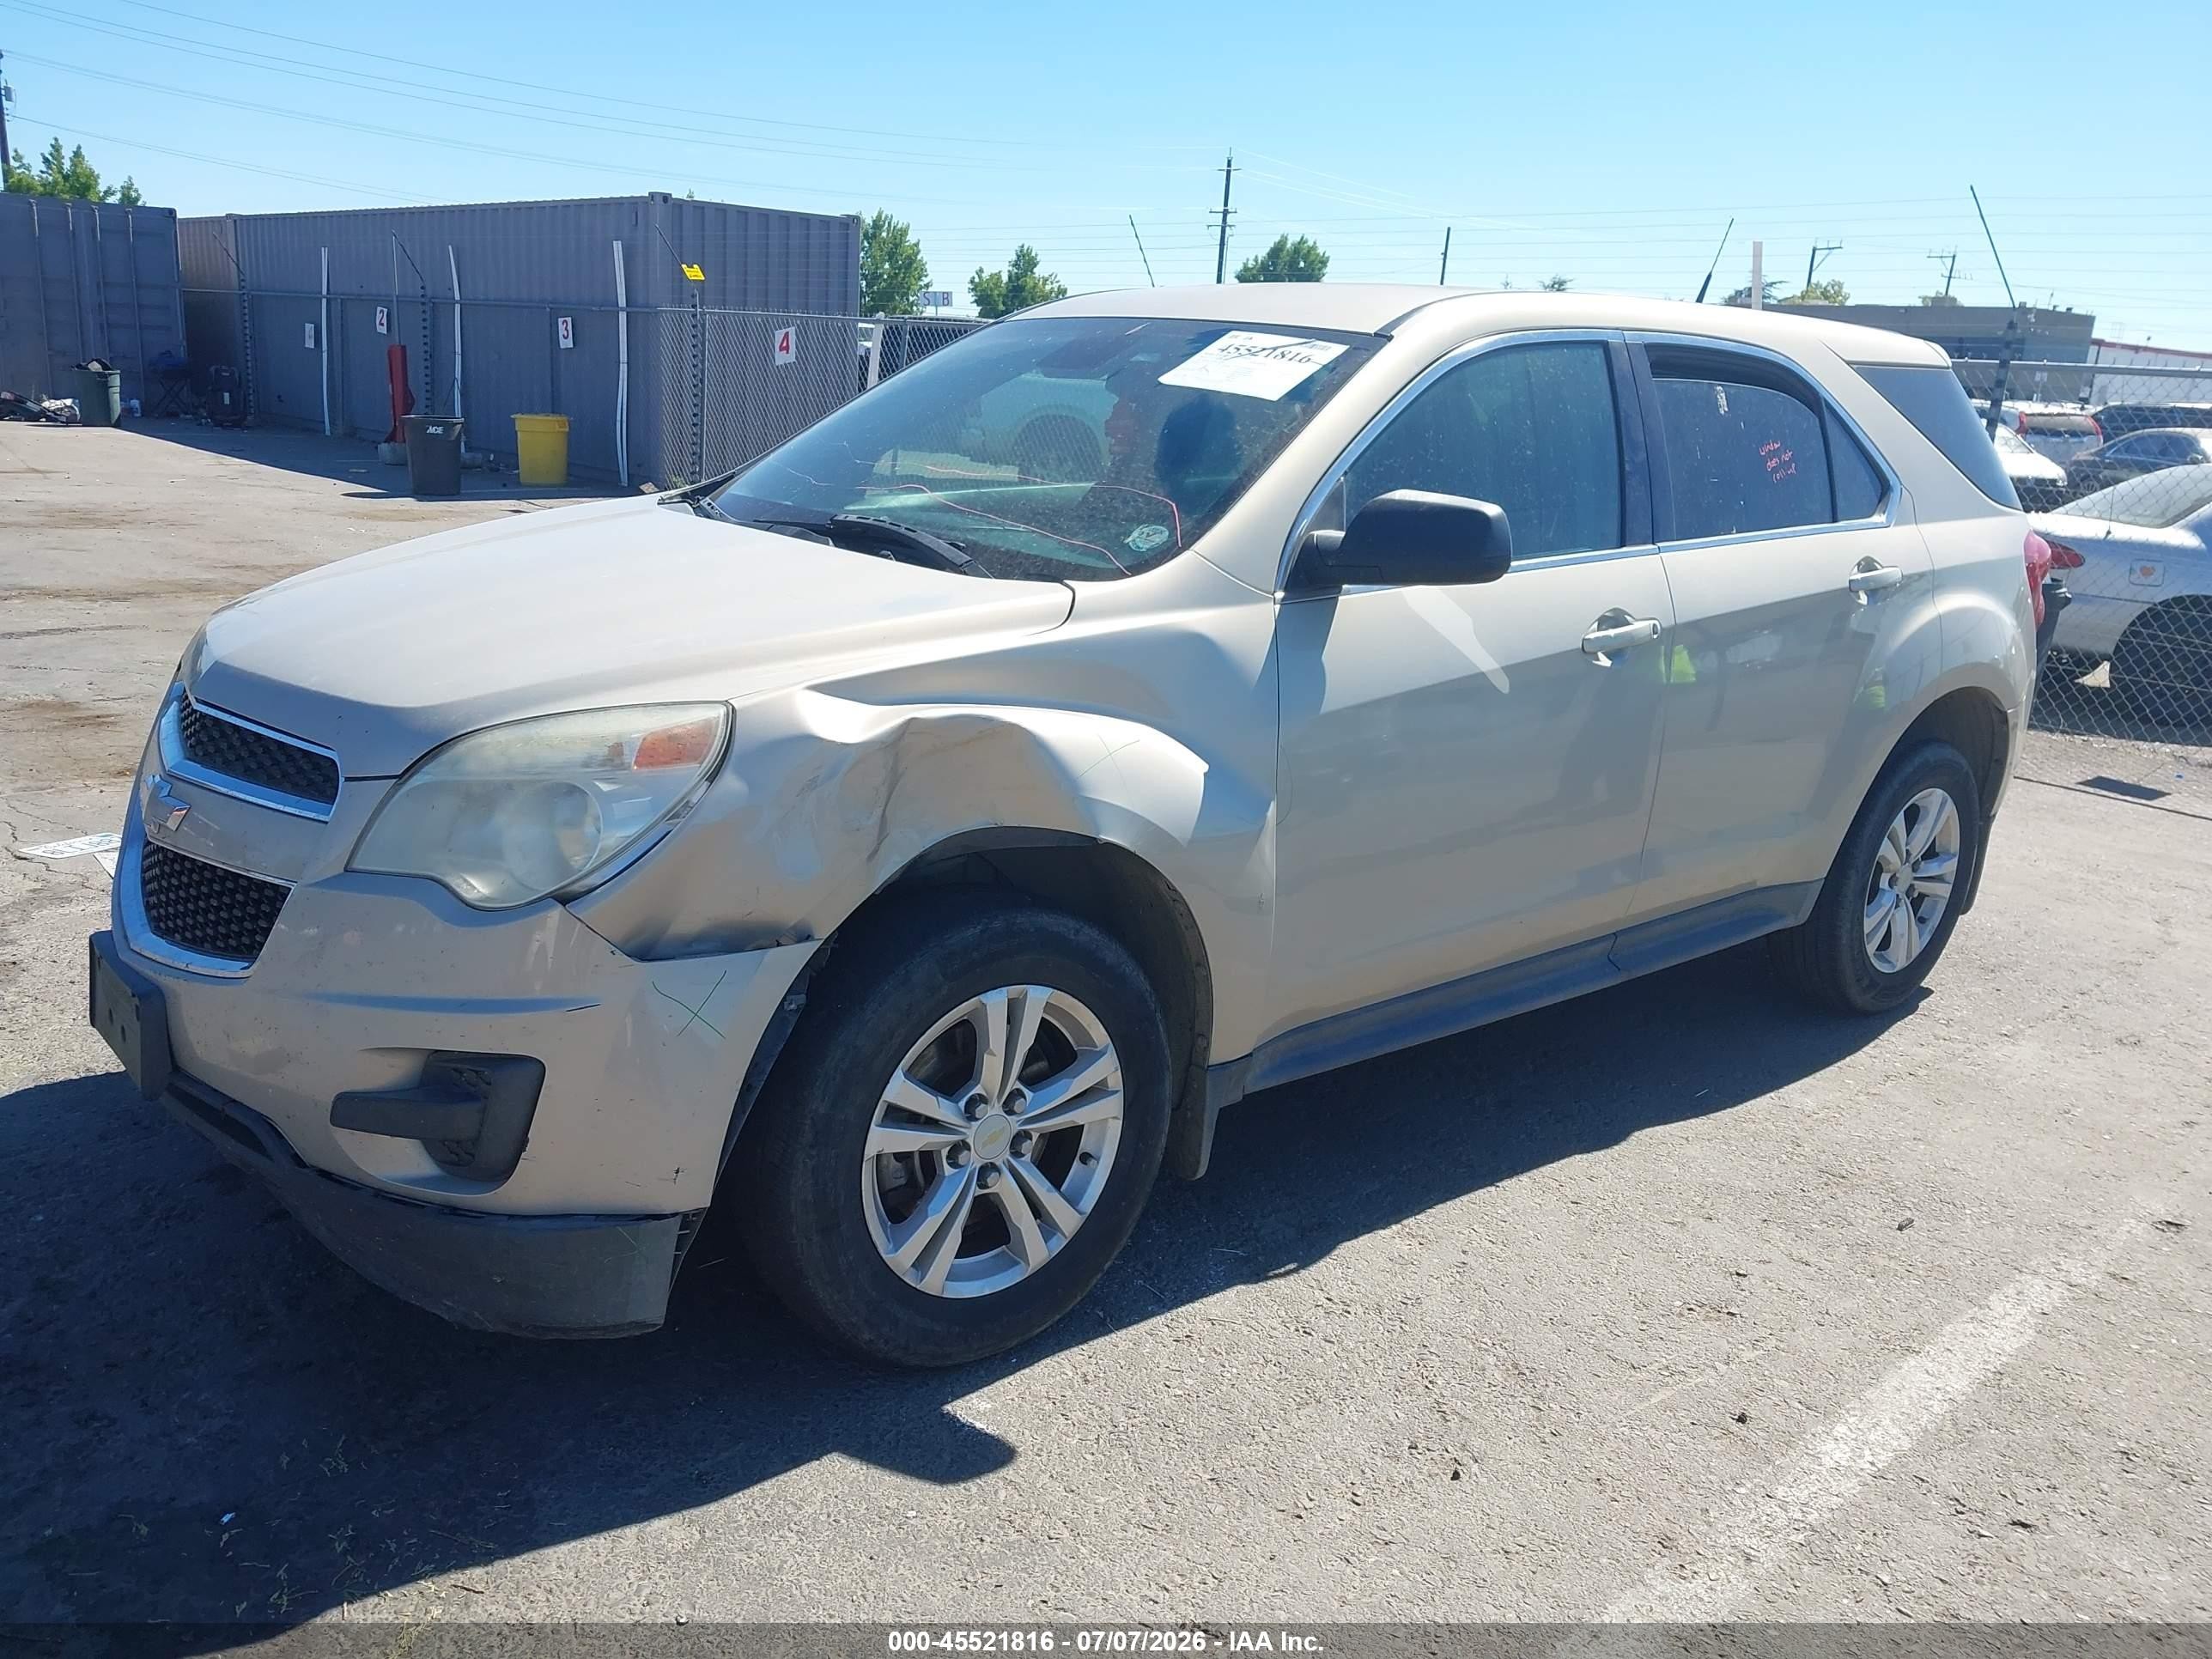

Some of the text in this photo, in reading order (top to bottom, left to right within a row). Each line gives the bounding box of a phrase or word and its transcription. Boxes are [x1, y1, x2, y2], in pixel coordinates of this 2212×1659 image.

[379, 309, 386, 327] 2
[562, 319, 569, 340] 3
[778, 331, 790, 355] 4
[426, 425, 444, 434] ACE
